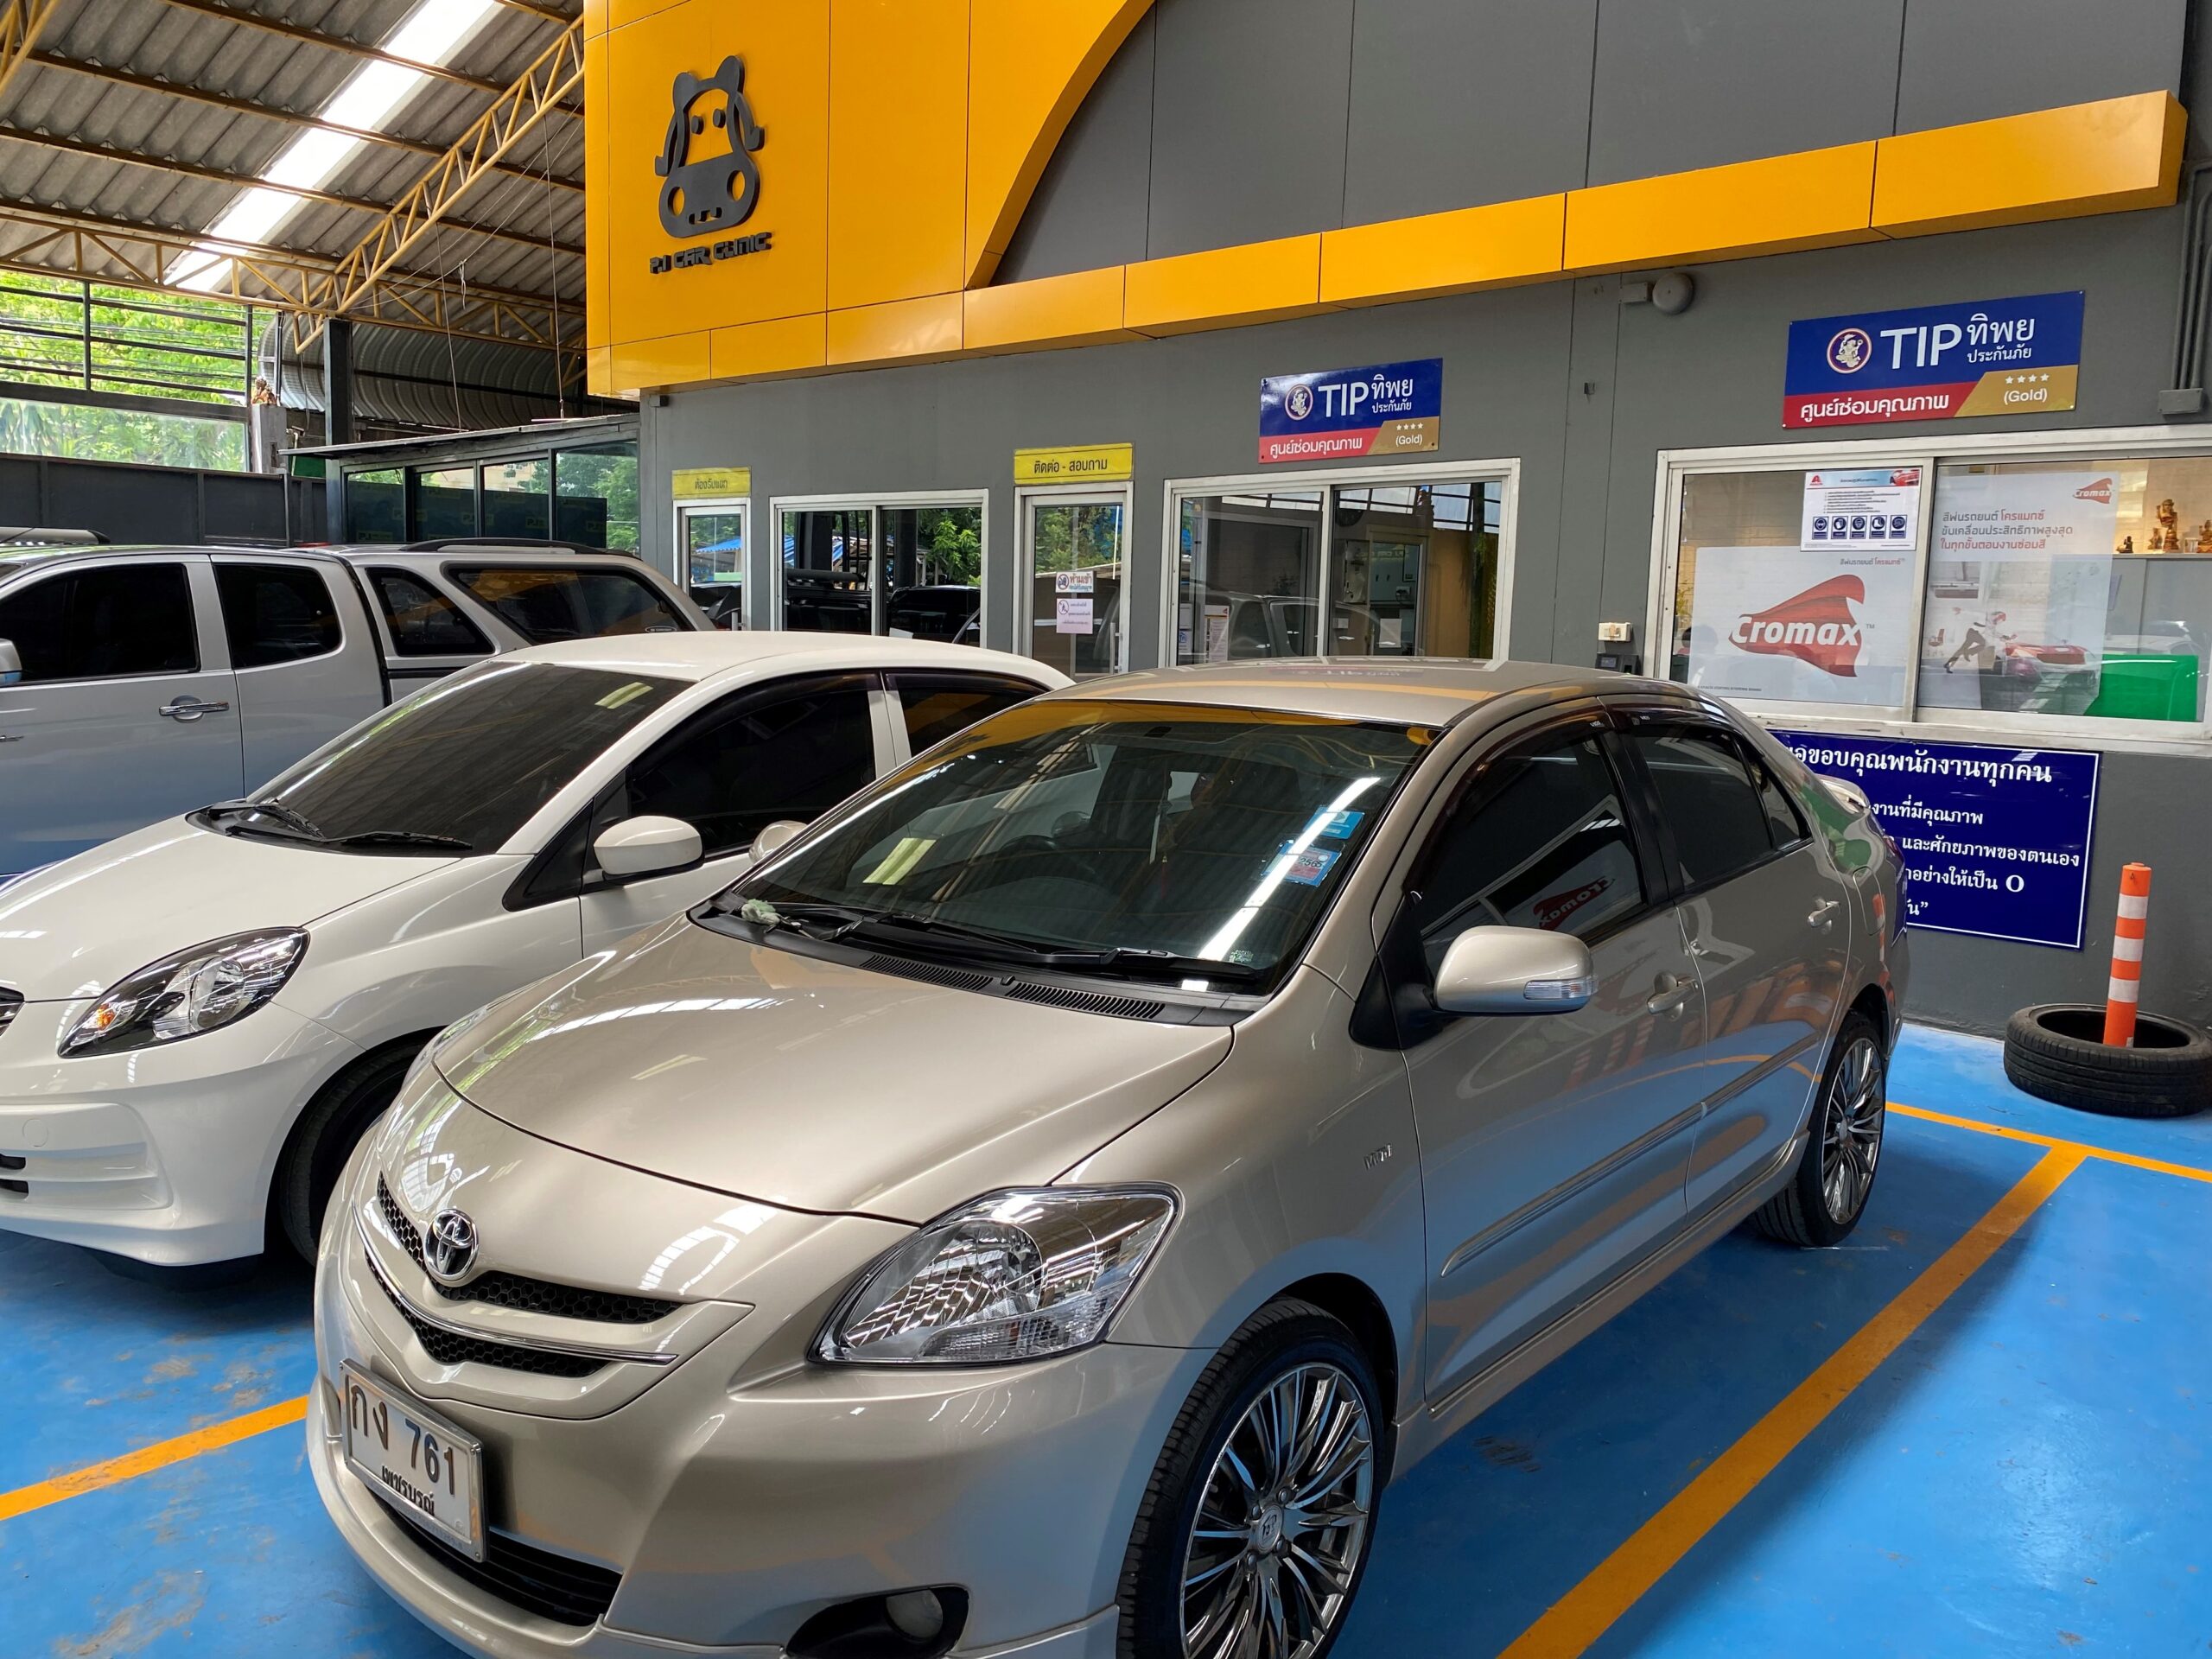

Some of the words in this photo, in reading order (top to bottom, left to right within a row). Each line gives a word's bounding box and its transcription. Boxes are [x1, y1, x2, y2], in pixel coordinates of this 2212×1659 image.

[674, 246, 713, 269] CAR
[713, 232, 772, 260] CLINIC
[1967, 313, 2035, 346] ทิพย
[1880, 323, 1962, 370] TIP
[1967, 343, 2032, 364] ประกันภัย
[1371, 373, 1414, 400] ทิพย
[2004, 388, 2048, 405] (Gold)
[1318, 382, 1369, 417] TIP
[1371, 398, 1412, 414] ประกันภัย
[1800, 394, 1949, 423] ศูนย์ซ่อมคุณภาพ
[1269, 437, 1363, 459] ศูนย์ซ่อมคุณภาพ
[1395, 434, 1423, 447] (Gold)
[1033, 459, 1059, 474] ติดต่อ
[1069, 459, 1108, 472] สอบถาม
[2073, 489, 2111, 498] Cromax
[1942, 510, 1999, 522] สีพ่นรถยนต์
[2000, 508, 2045, 522] โครแมกซ์
[1942, 523, 2074, 537] ขับเคลื่อนประสิทธิภาพสูงสุด
[1941, 537, 2046, 552] ในทุกขั้นตอนงานซ่อมสี
[1732, 616, 1860, 646] Cromax
[1788, 746, 2052, 787] อขอบคุณพนักงานทุกคน
[1869, 795, 1983, 827] งานที่มีคุณภาพ
[1300, 857, 1323, 868] 2565
[1902, 834, 2080, 867] และศักยภาพของตนเอง
[351, 1384, 388, 1451] กง
[405, 1418, 455, 1497] 761
